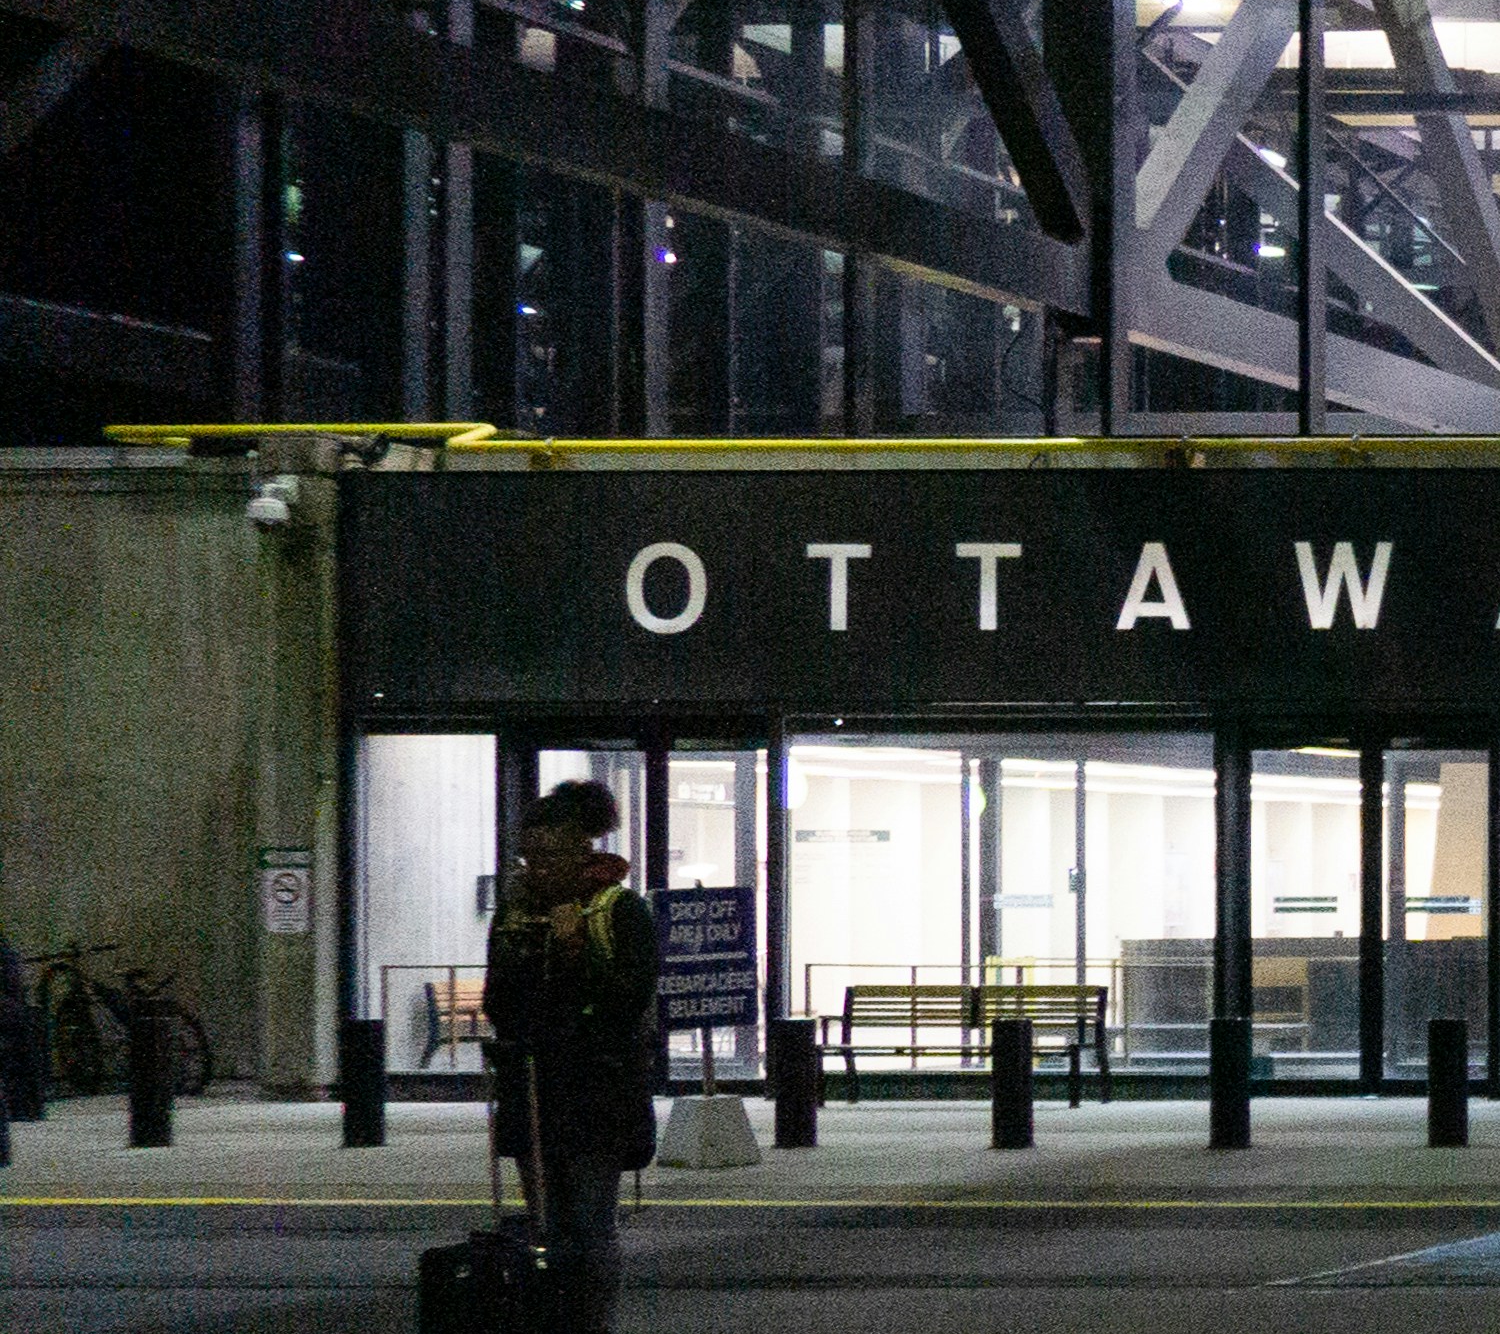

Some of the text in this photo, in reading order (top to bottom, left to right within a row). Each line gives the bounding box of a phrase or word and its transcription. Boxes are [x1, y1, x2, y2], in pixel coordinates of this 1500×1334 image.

[669, 899, 737, 921] DROP OFF
[668, 921, 742, 945] AREA ONLY
[668, 996, 747, 1018] SEULEMENT
